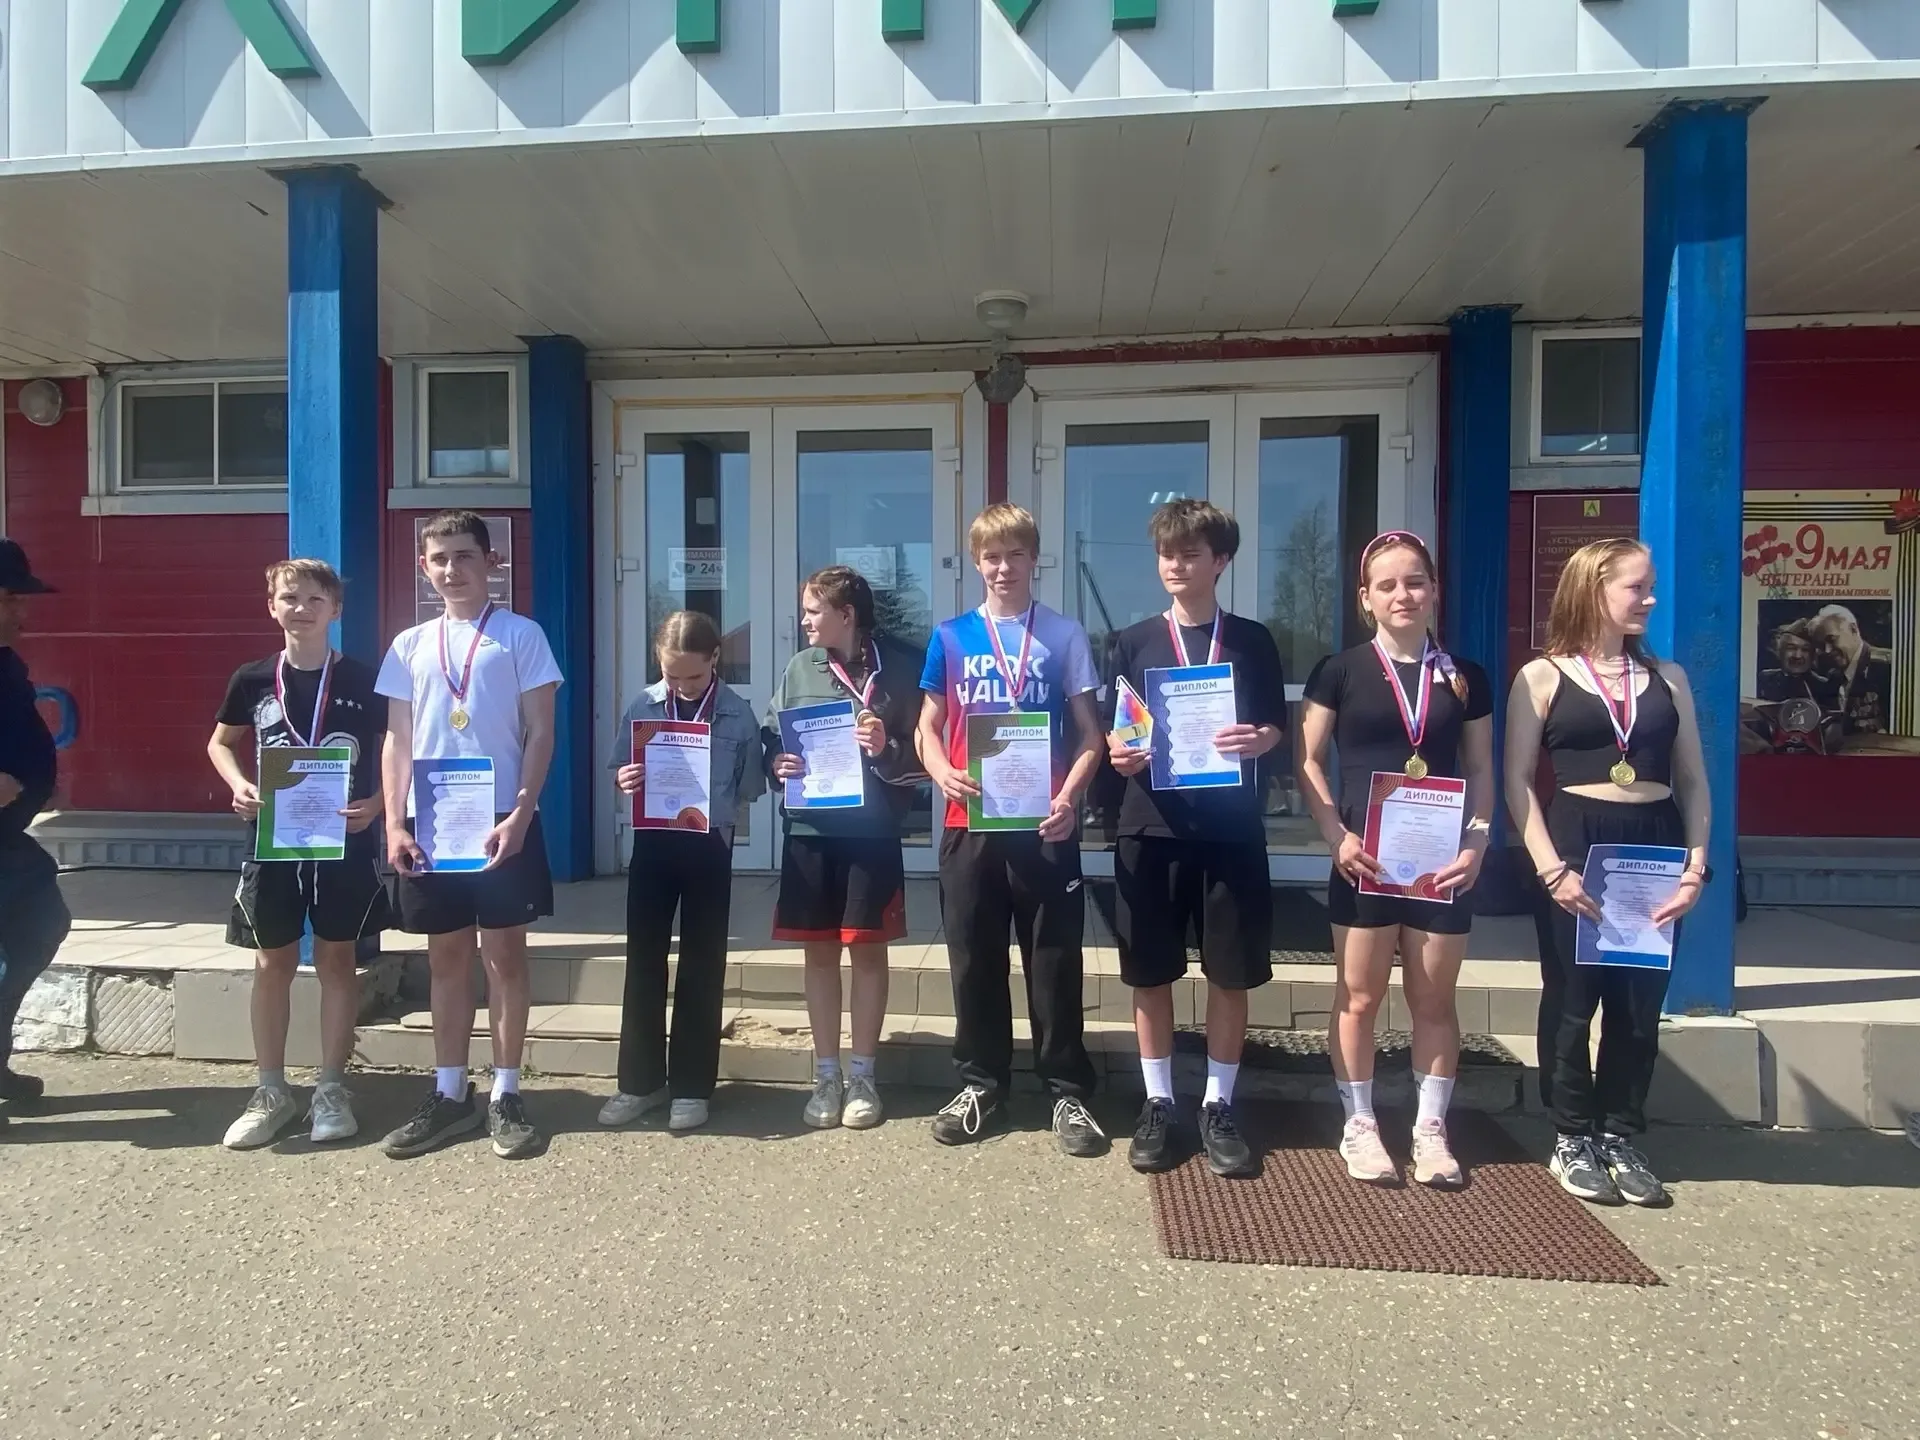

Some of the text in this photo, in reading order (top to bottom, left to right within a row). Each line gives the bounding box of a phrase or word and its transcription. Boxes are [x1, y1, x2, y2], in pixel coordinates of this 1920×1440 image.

[1795, 523, 1892, 570] 9 МАЯ
[1760, 573, 1851, 587] ВЕТЕРАНЫ
[1835, 588, 1854, 597] ВАМ
[963, 654, 1045, 679] КРОСС
[955, 679, 1050, 707] НАЦИИ
[1173, 681, 1218, 693] ДИПЛОМ
[804, 717, 842, 729] ДИПЛОМ
[1001, 727, 1044, 737] ДИПЛОМ
[662, 734, 703, 744] ДИПЛОМ
[298, 761, 344, 770] ДИПЛОМ
[441, 773, 481, 782] ДИПЛОМ
[1403, 790, 1454, 803] ДИПЛОМ
[1616, 861, 1667, 871] ДИПЛОМ
